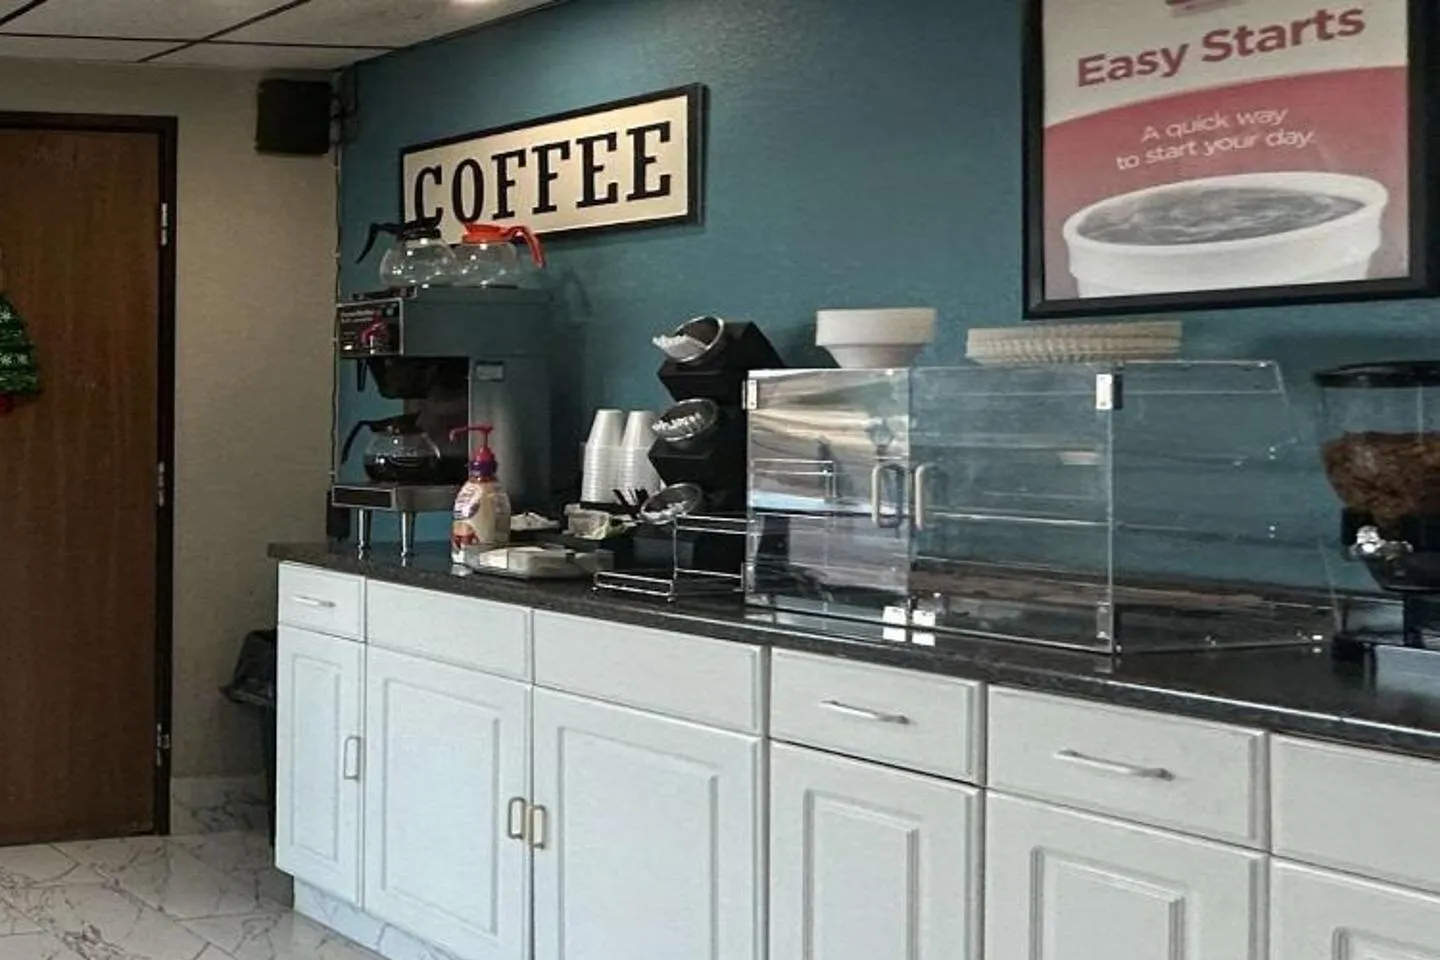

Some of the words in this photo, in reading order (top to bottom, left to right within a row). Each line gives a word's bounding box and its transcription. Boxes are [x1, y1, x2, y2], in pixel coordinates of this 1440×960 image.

[1078, 43, 1189, 87] Easy
[1201, 8, 1366, 62] Starts
[1116, 154, 1140, 170] to
[1145, 141, 1198, 164] start
[1204, 133, 1258, 157] your
[1141, 125, 1159, 143] A
[1165, 112, 1229, 139] quick
[1236, 108, 1288, 126] way
[414, 121, 672, 224] COFFEE
